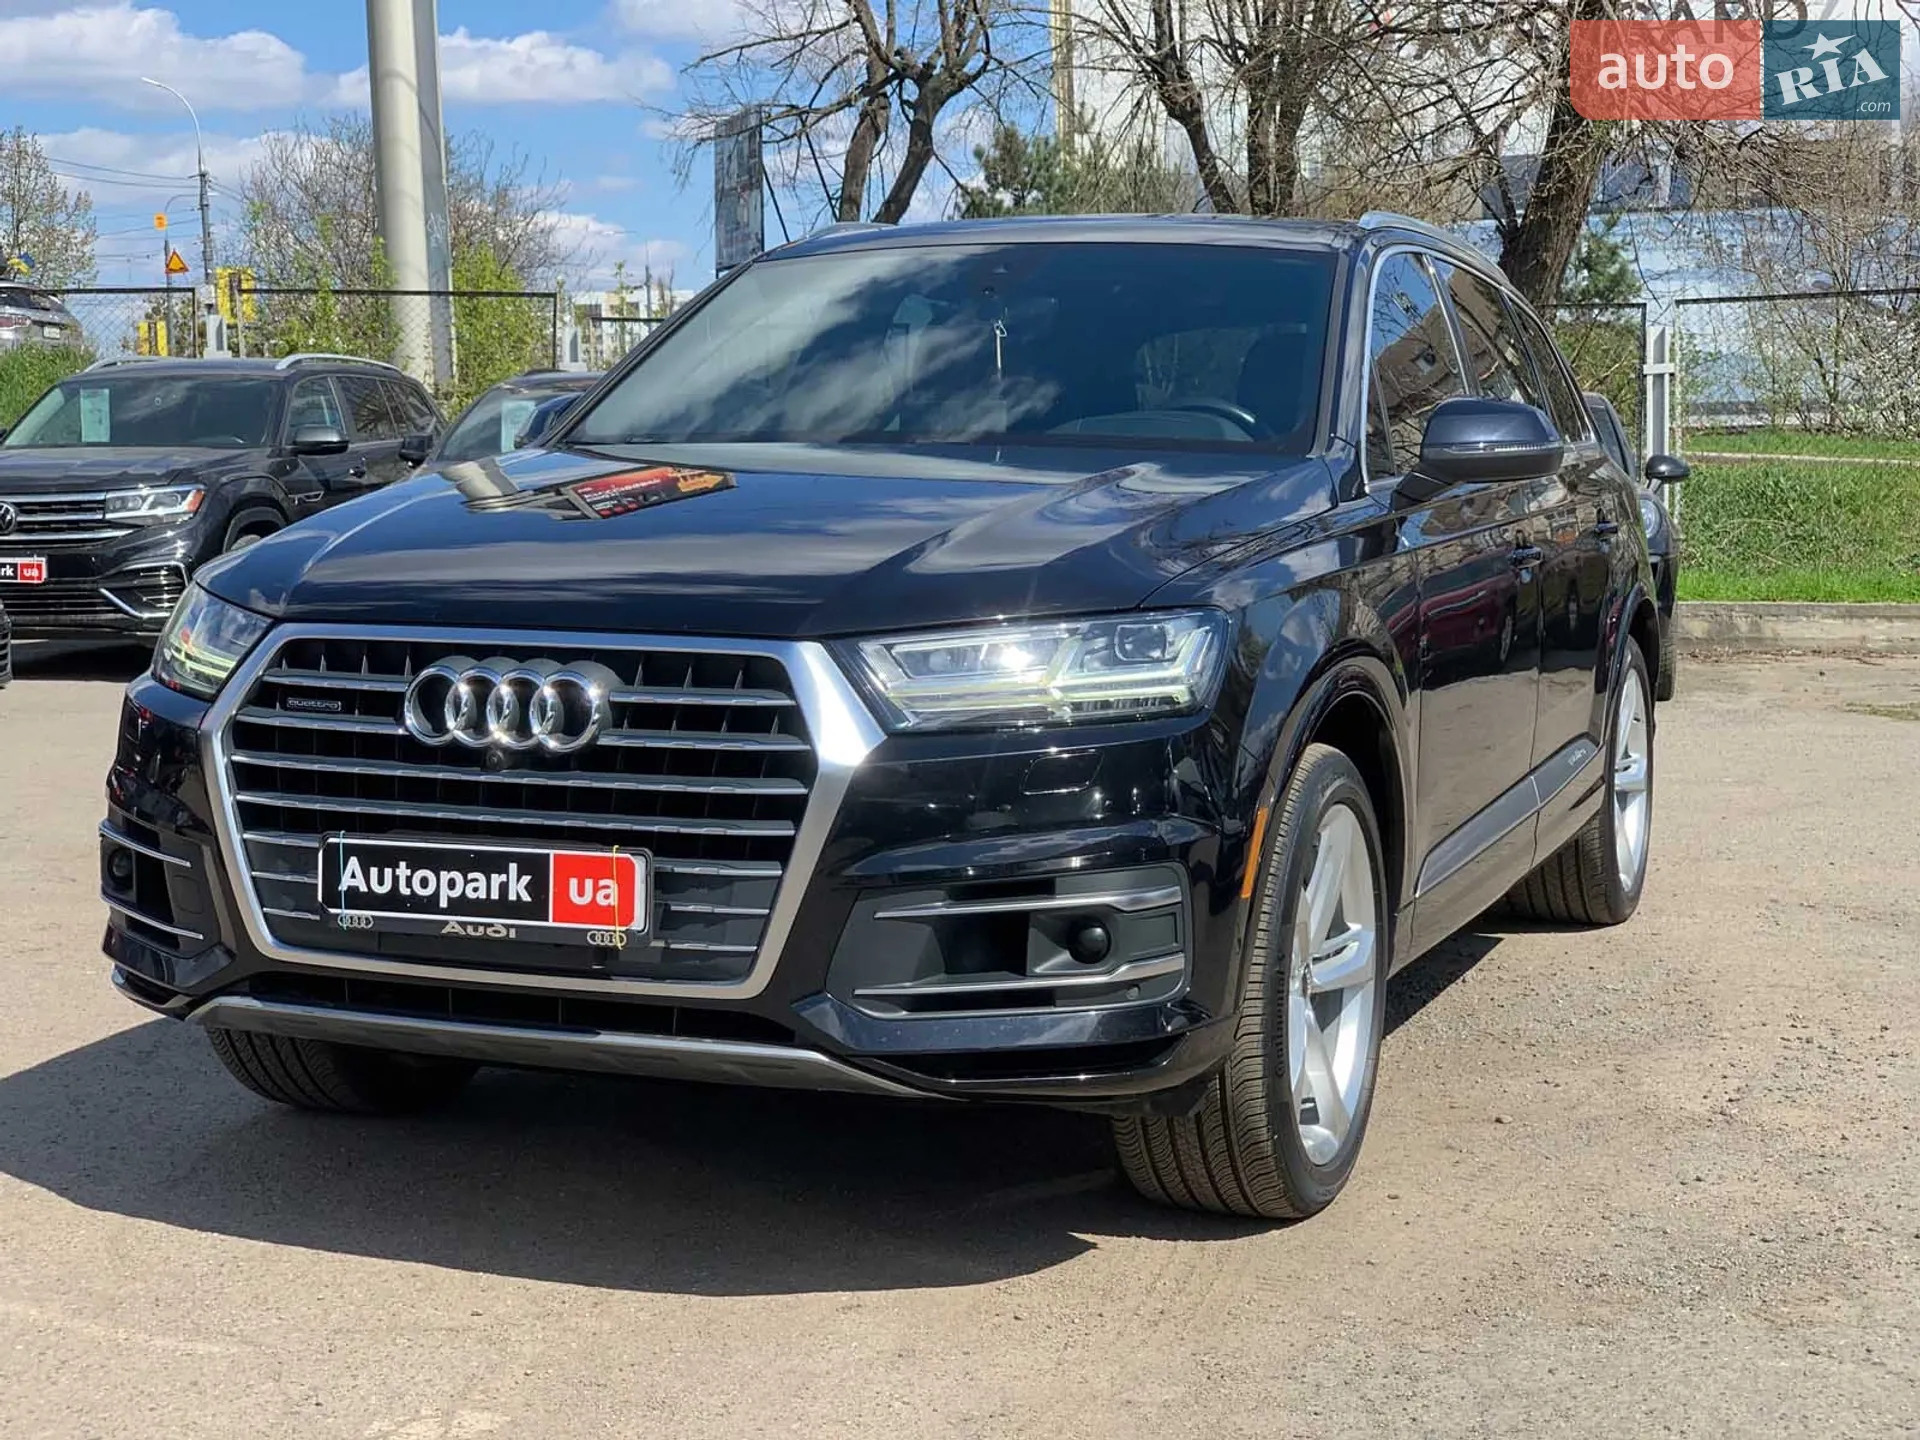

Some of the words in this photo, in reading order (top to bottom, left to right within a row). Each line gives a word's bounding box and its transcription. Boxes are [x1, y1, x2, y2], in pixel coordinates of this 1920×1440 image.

[23, 568, 39, 577] ua
[338, 856, 532, 908] Autopark
[568, 876, 619, 907] ua
[440, 920, 516, 939] Audi
